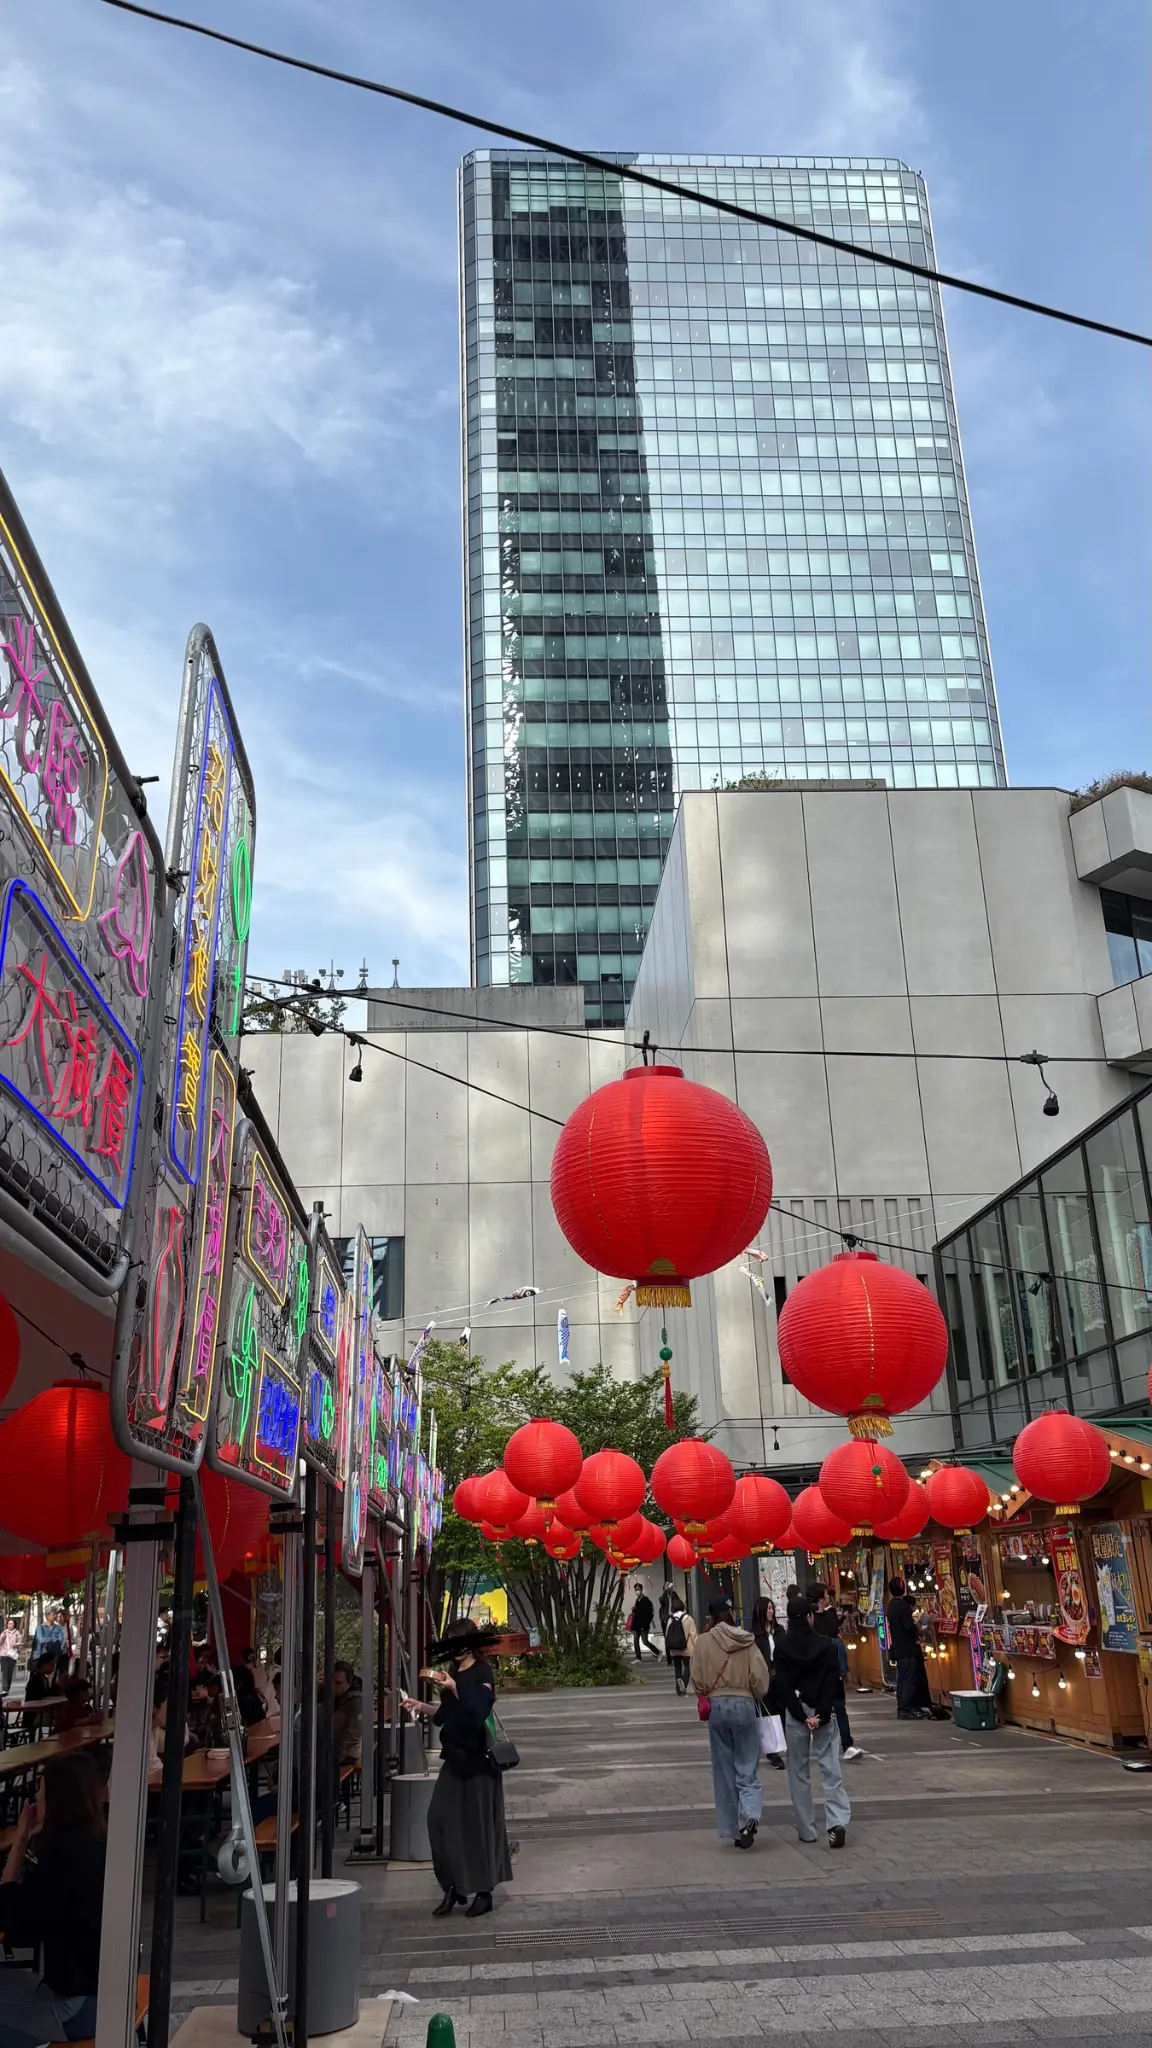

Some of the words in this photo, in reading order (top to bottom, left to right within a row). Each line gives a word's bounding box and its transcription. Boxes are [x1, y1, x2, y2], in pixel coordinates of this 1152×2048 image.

[0, 952, 134, 1177] 大減價
[177, 744, 225, 1131] 招財進寶
[195, 1102, 231, 1385] 大減價
